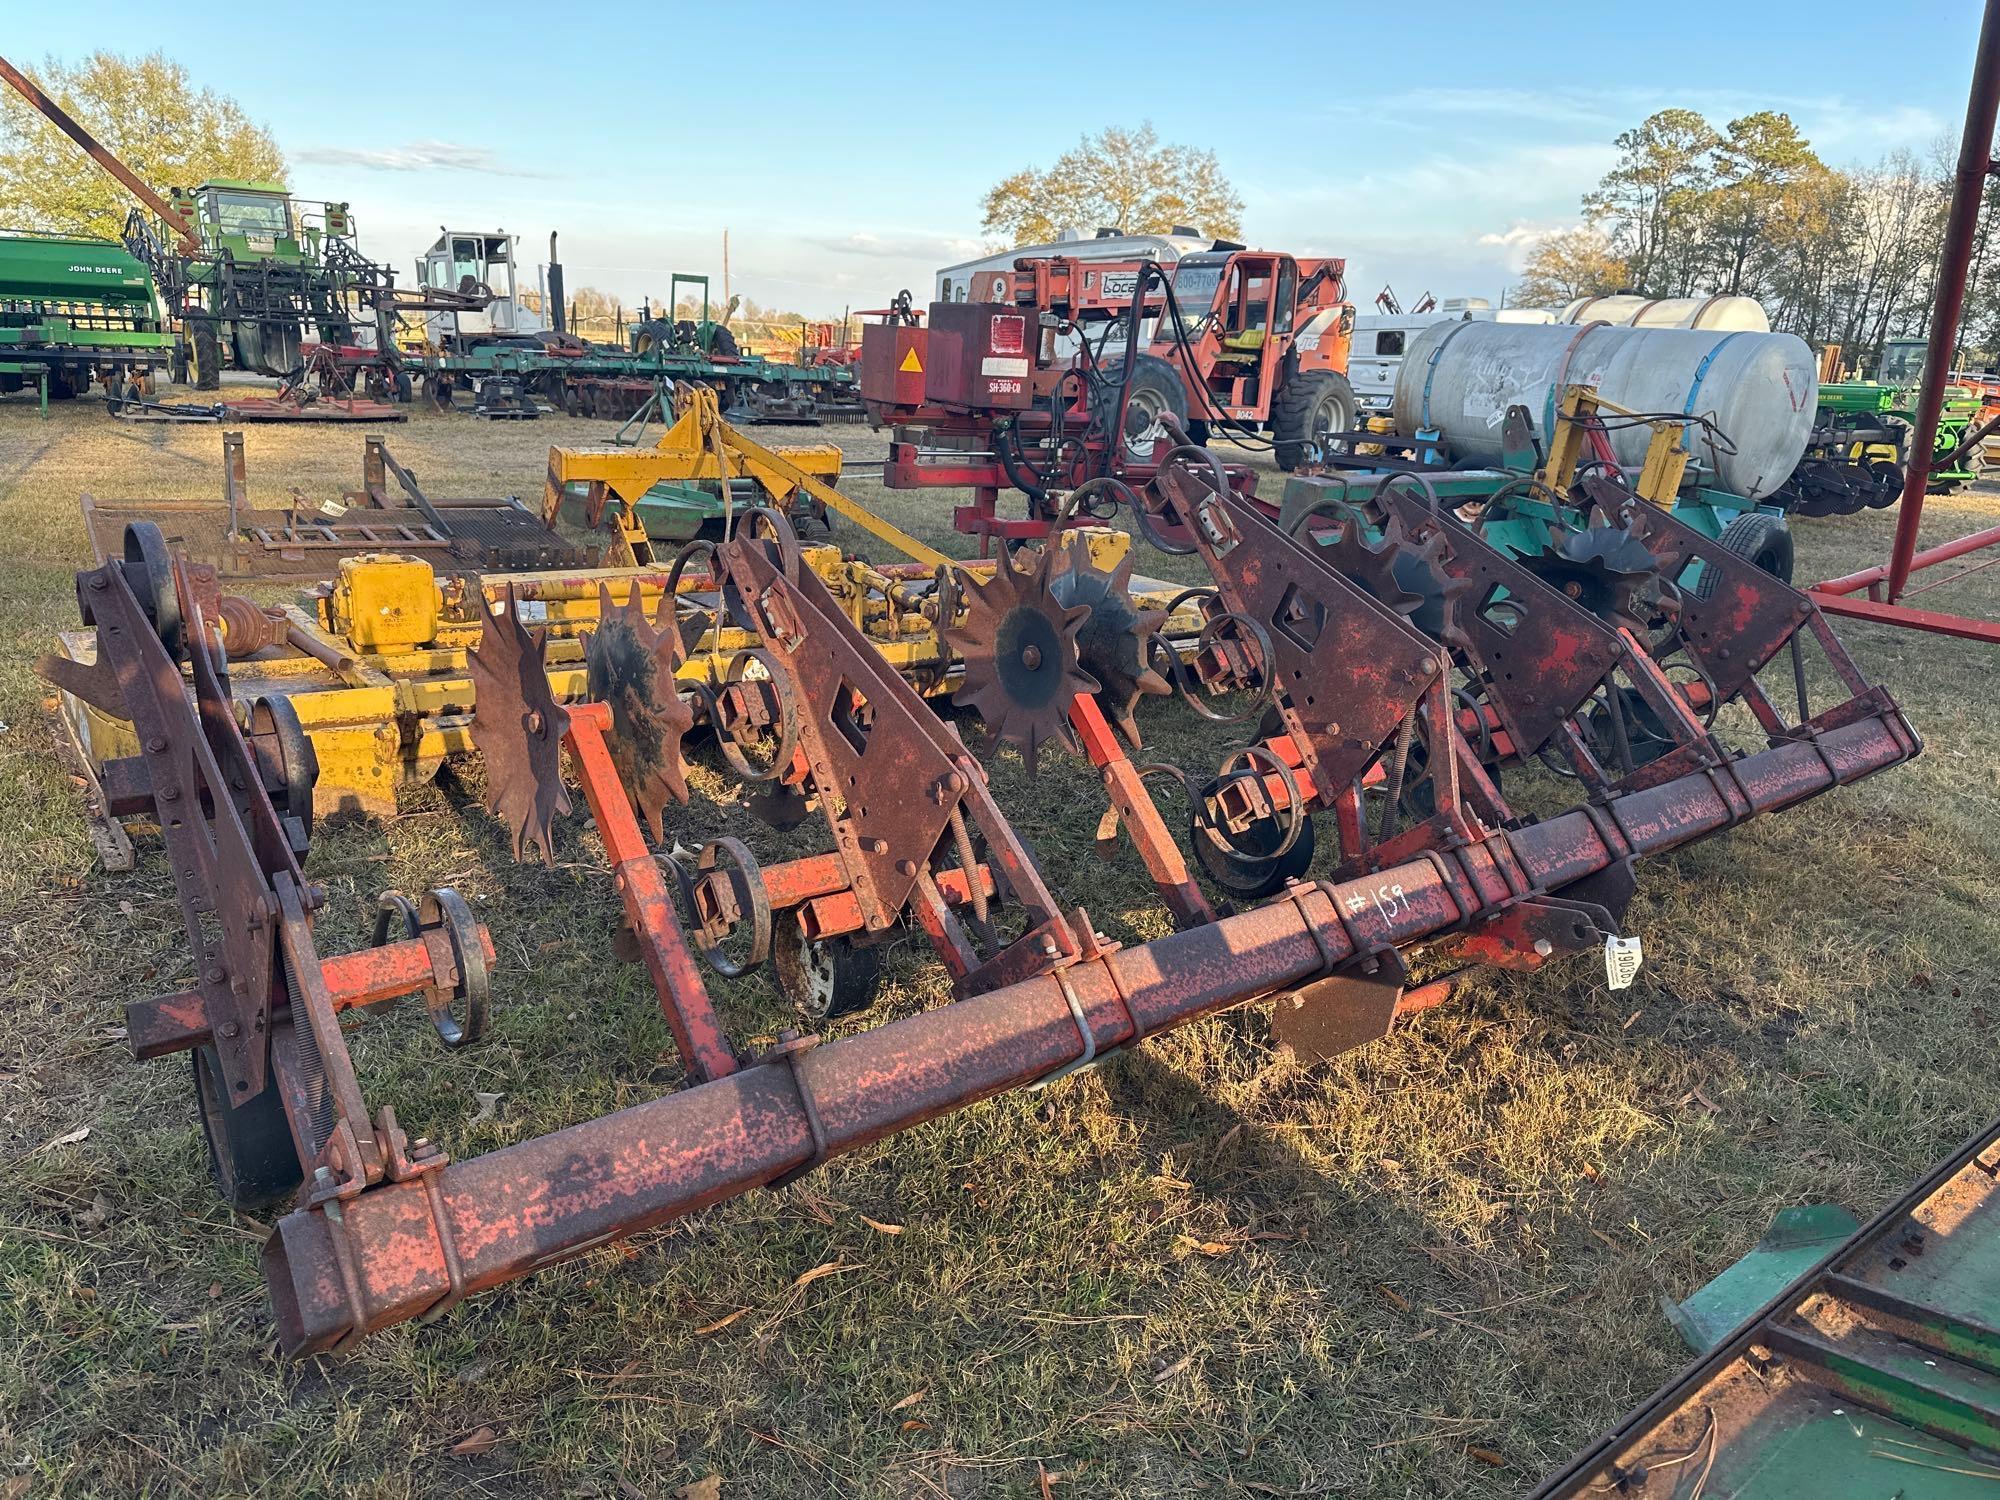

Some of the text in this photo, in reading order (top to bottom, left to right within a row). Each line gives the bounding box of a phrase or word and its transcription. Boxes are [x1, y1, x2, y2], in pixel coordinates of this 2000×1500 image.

[68, 265, 123, 275] JOHN DEERE
[996, 282, 1003, 292] 8
